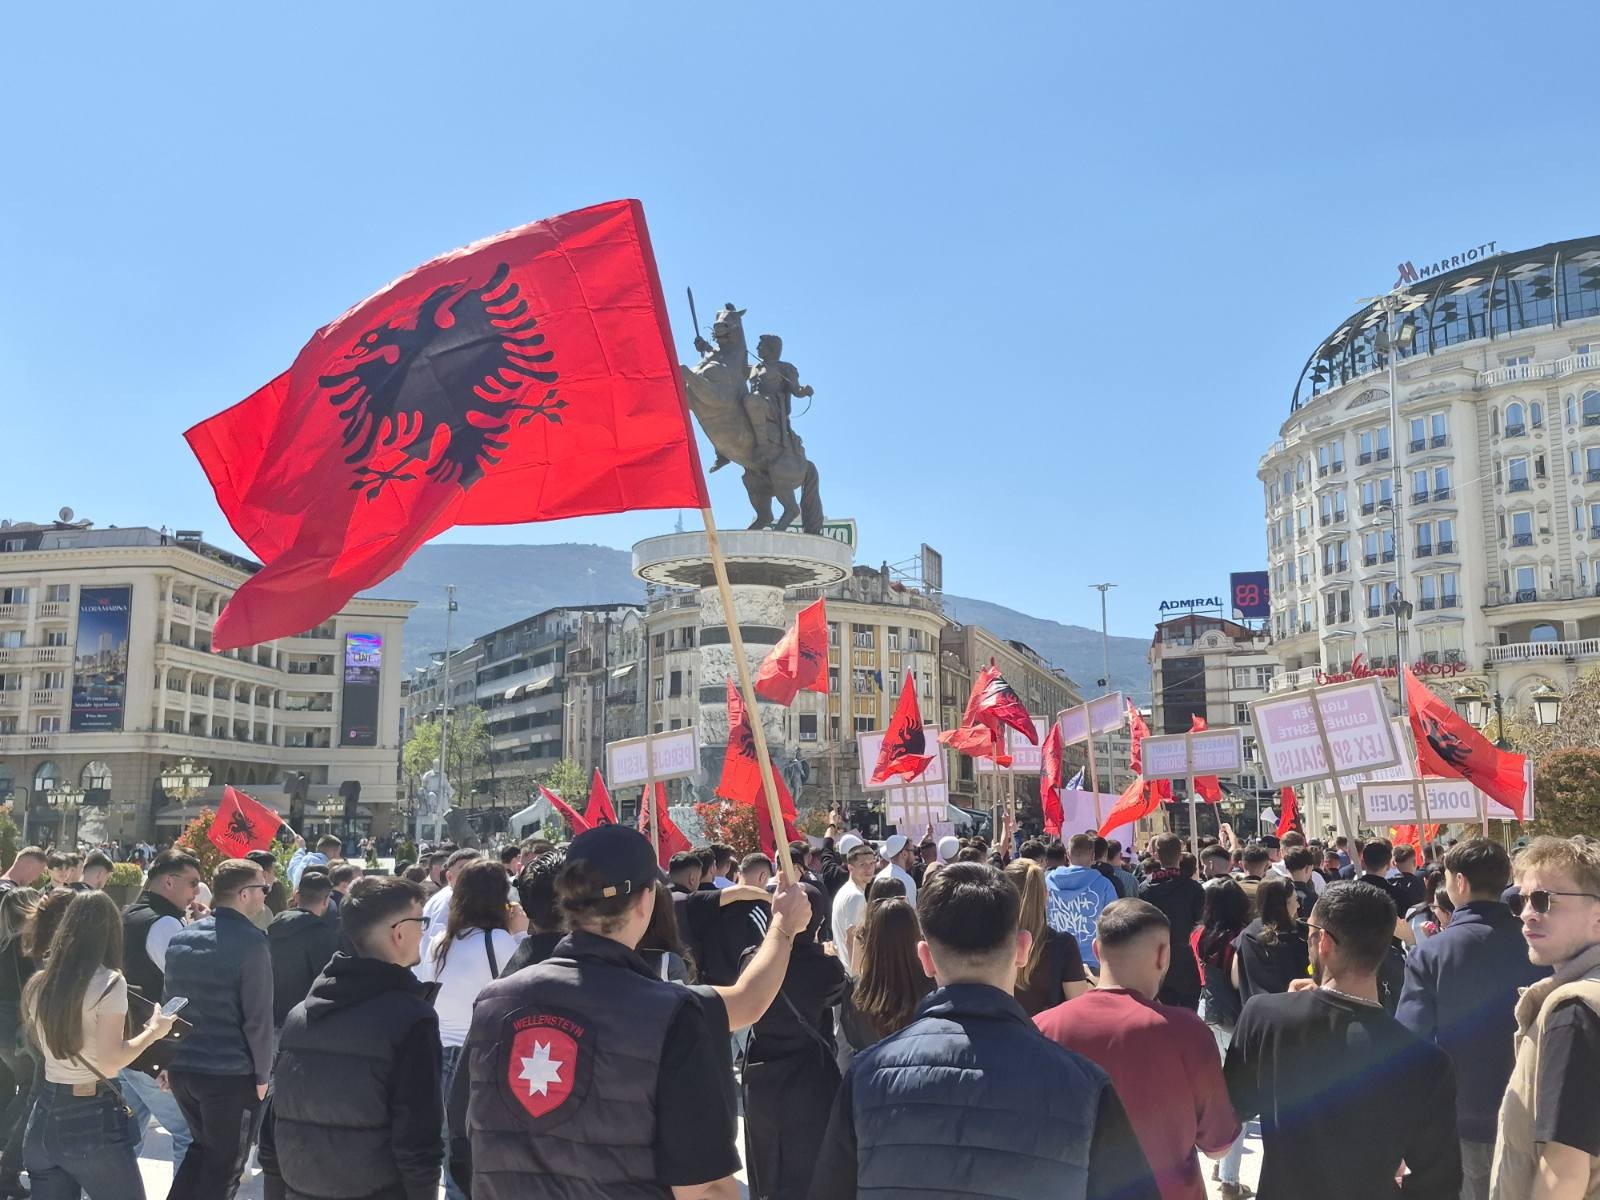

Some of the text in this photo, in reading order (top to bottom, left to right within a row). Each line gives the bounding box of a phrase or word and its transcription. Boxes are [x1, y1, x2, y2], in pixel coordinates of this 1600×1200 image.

[1419, 240, 1497, 279] MARRIOTT
[1159, 596, 1224, 611] ADMIRAL
[512, 1013, 585, 1038] WELLENSTEYN
